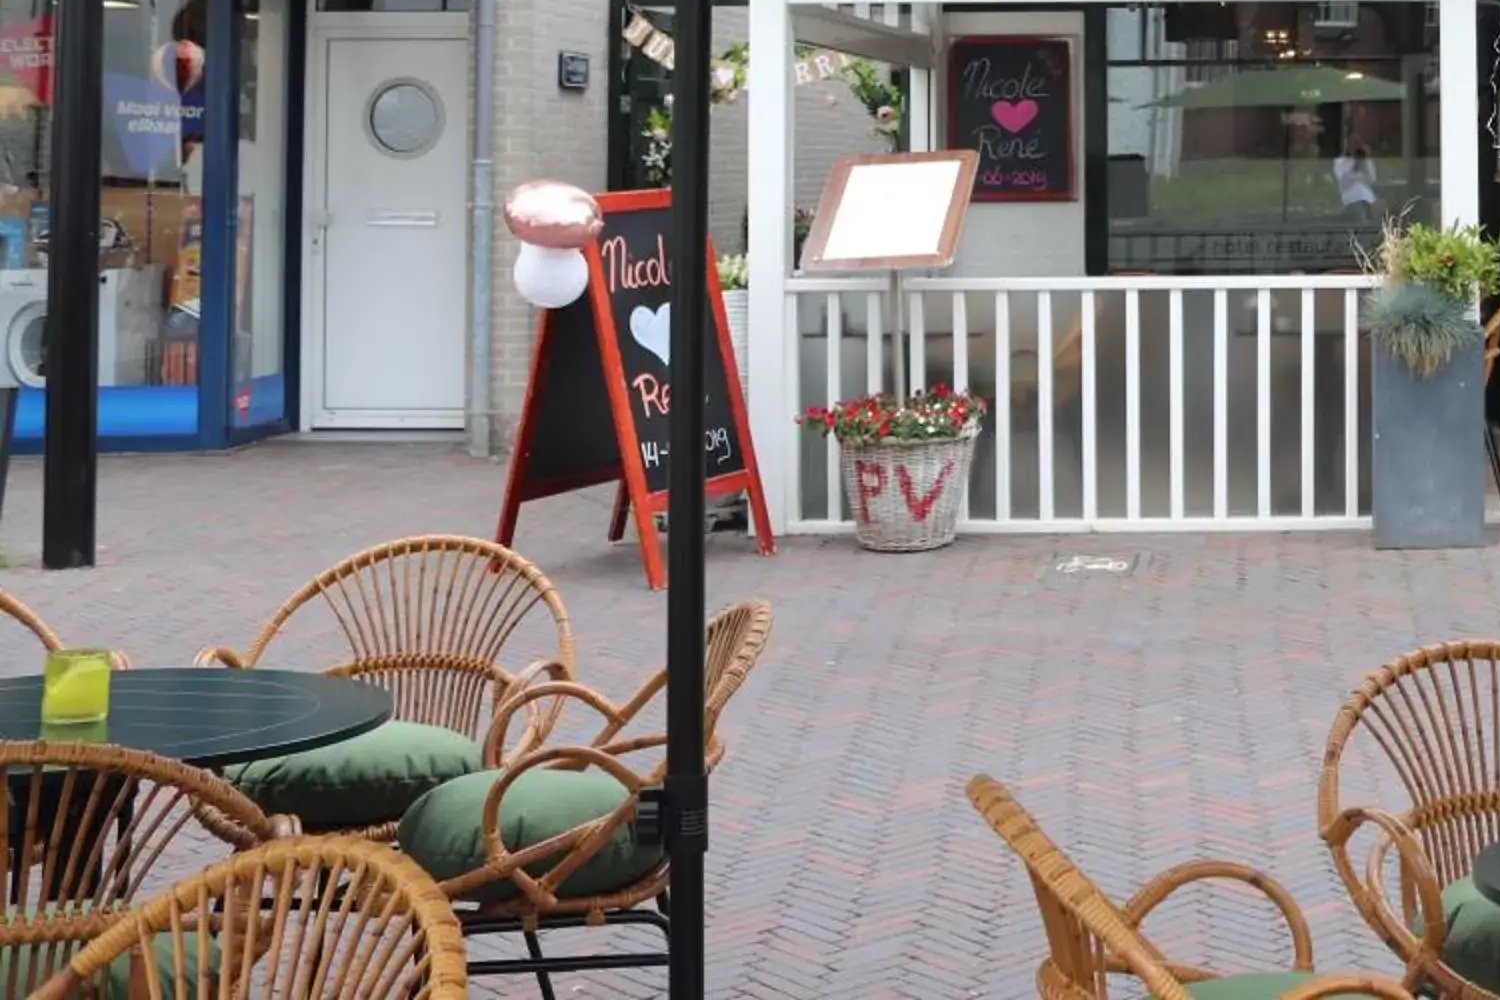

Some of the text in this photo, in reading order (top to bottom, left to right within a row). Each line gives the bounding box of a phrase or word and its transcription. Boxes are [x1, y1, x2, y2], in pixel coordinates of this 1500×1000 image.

[963, 57, 1050, 100] Nicole
[972, 124, 1046, 160] René
[982, 166, 1047, 191] 06-2019
[602, 233, 672, 294] Nicol
[632, 373, 671, 418] Re
